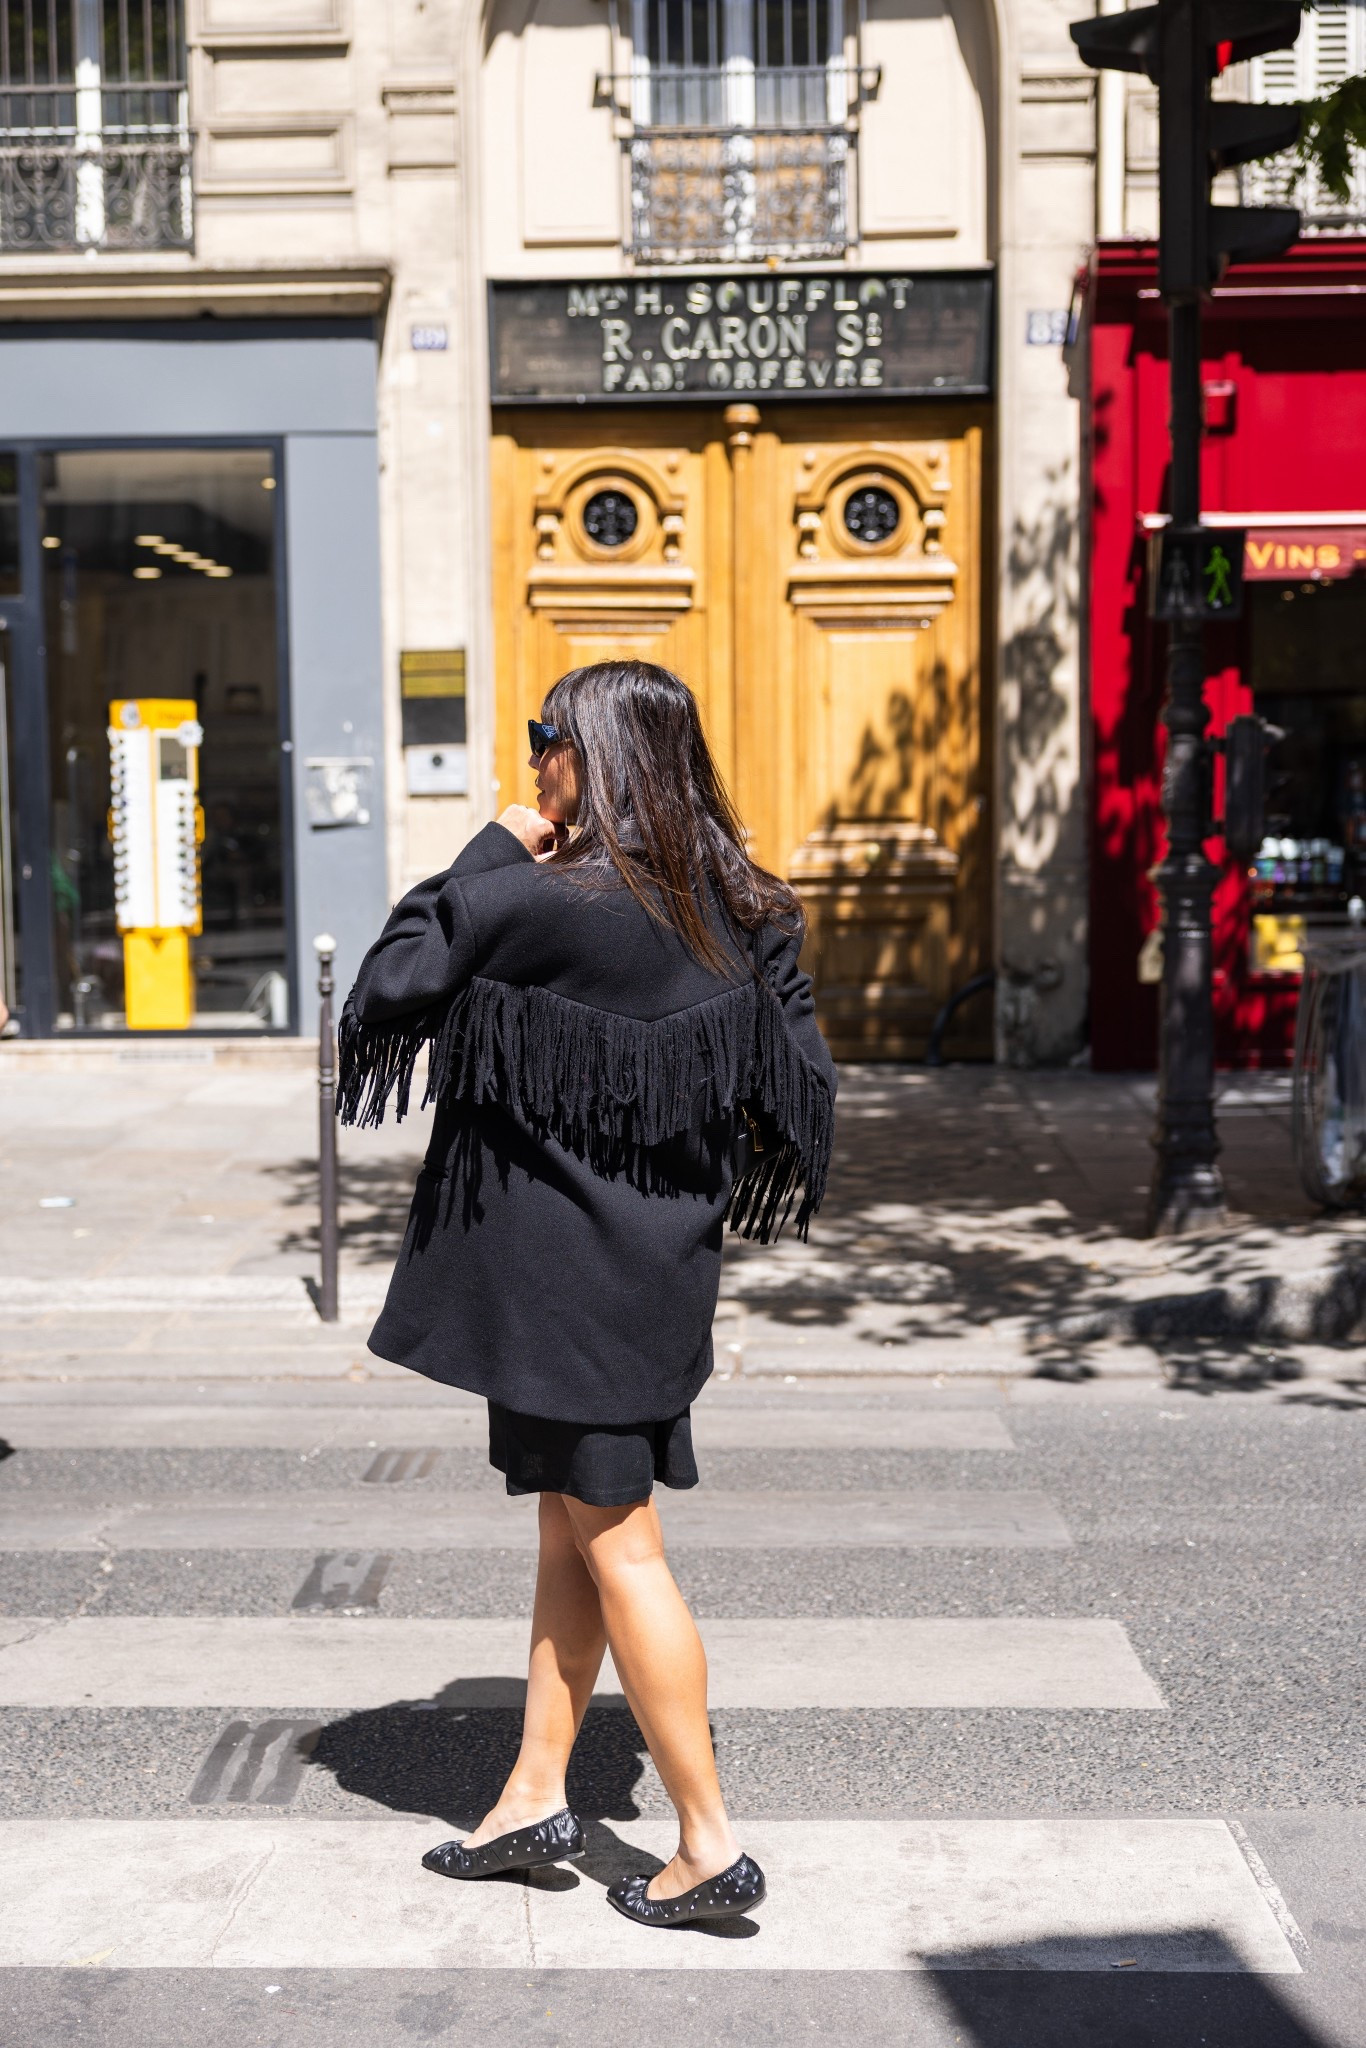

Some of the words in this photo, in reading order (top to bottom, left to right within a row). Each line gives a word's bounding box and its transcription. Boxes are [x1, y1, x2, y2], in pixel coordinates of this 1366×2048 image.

[634, 281, 674, 315] H.
[686, 278, 914, 315] SOUFFLOT
[601, 318, 653, 361] R.
[661, 314, 808, 361] CARON
[1244, 541, 1341, 570] VINS
